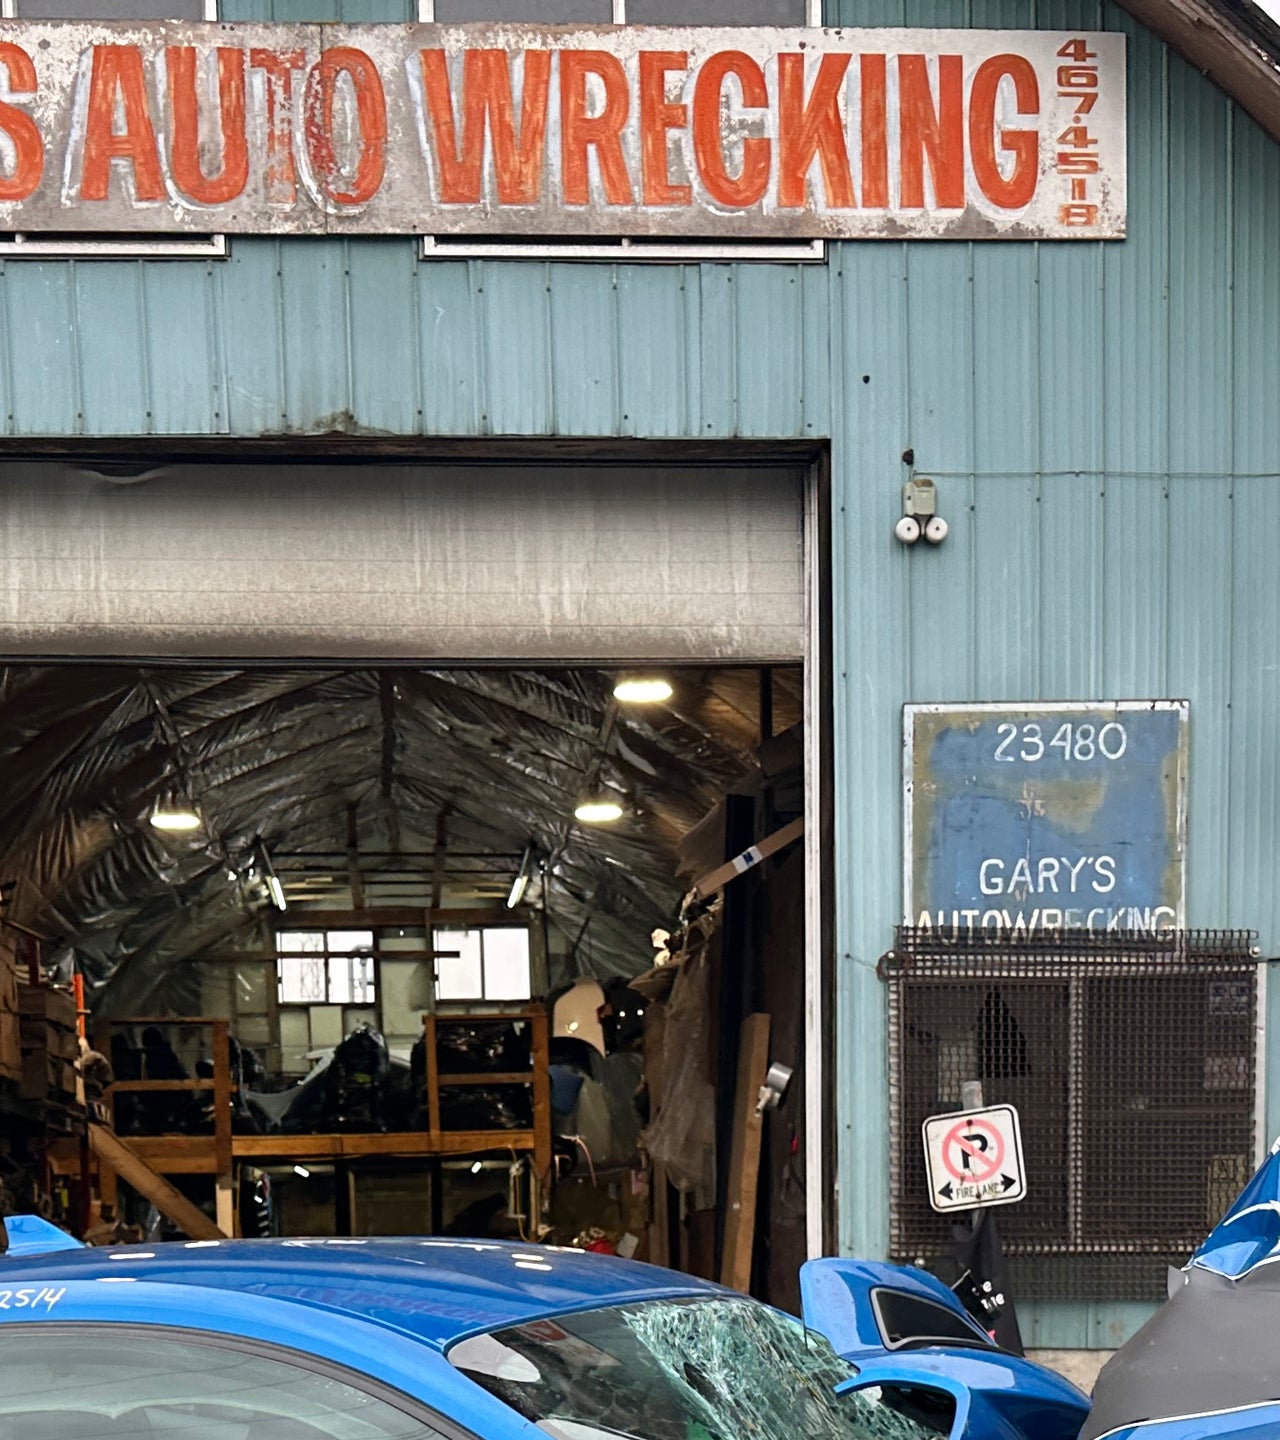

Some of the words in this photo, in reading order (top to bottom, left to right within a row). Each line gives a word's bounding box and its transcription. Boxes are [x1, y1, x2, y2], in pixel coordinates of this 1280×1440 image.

[77, 44, 388, 212] AUTO
[417, 47, 1041, 212] WRECKING
[993, 721, 1128, 763] 23480
[978, 855, 1117, 895] GARY'S
[955, 1185, 975, 1200] FIRE
[977, 1182, 1002, 1198] ANE
